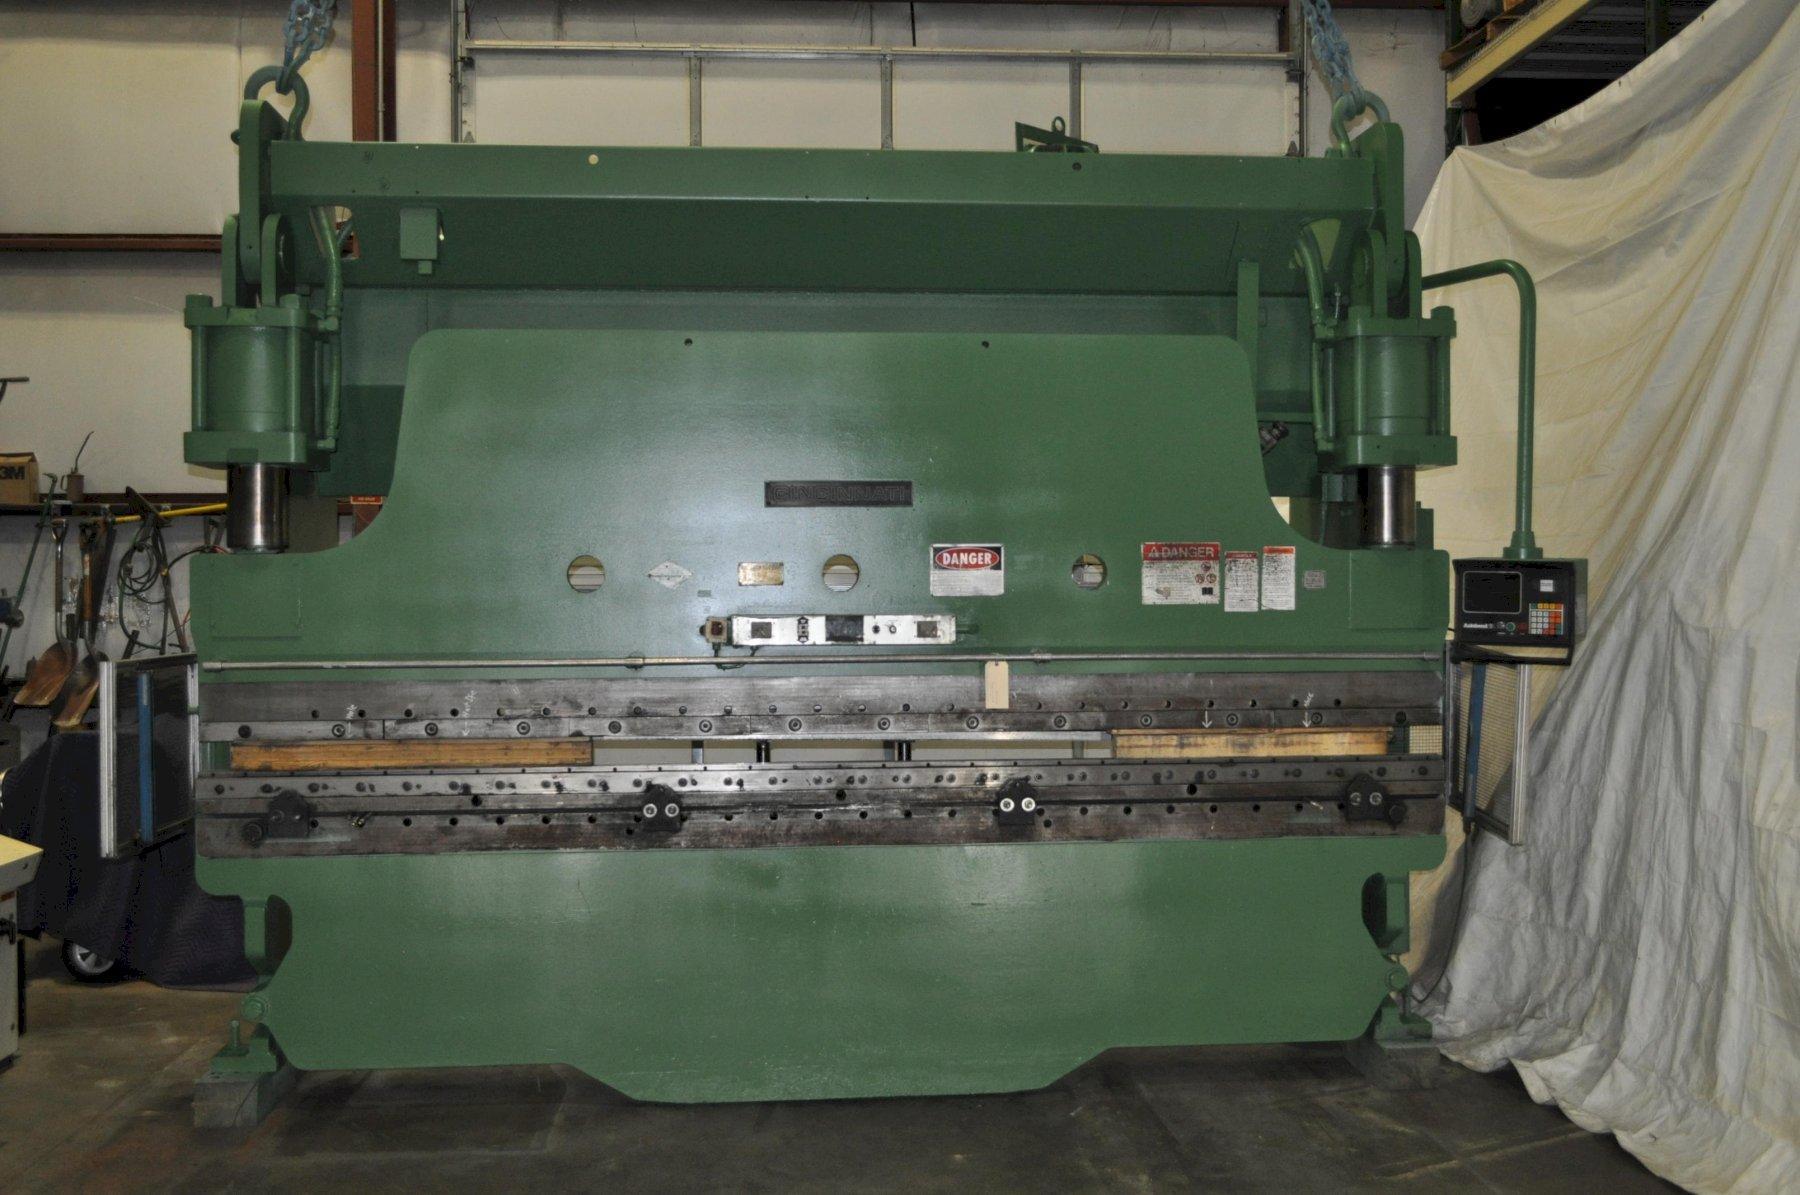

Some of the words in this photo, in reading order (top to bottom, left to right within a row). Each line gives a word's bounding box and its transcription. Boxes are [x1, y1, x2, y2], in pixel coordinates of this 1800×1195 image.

[0, 465, 25, 480] 3M
[771, 485, 906, 502] CINCINNATI
[942, 552, 992, 565] DANGER
[1161, 546, 1214, 558] DANGER
